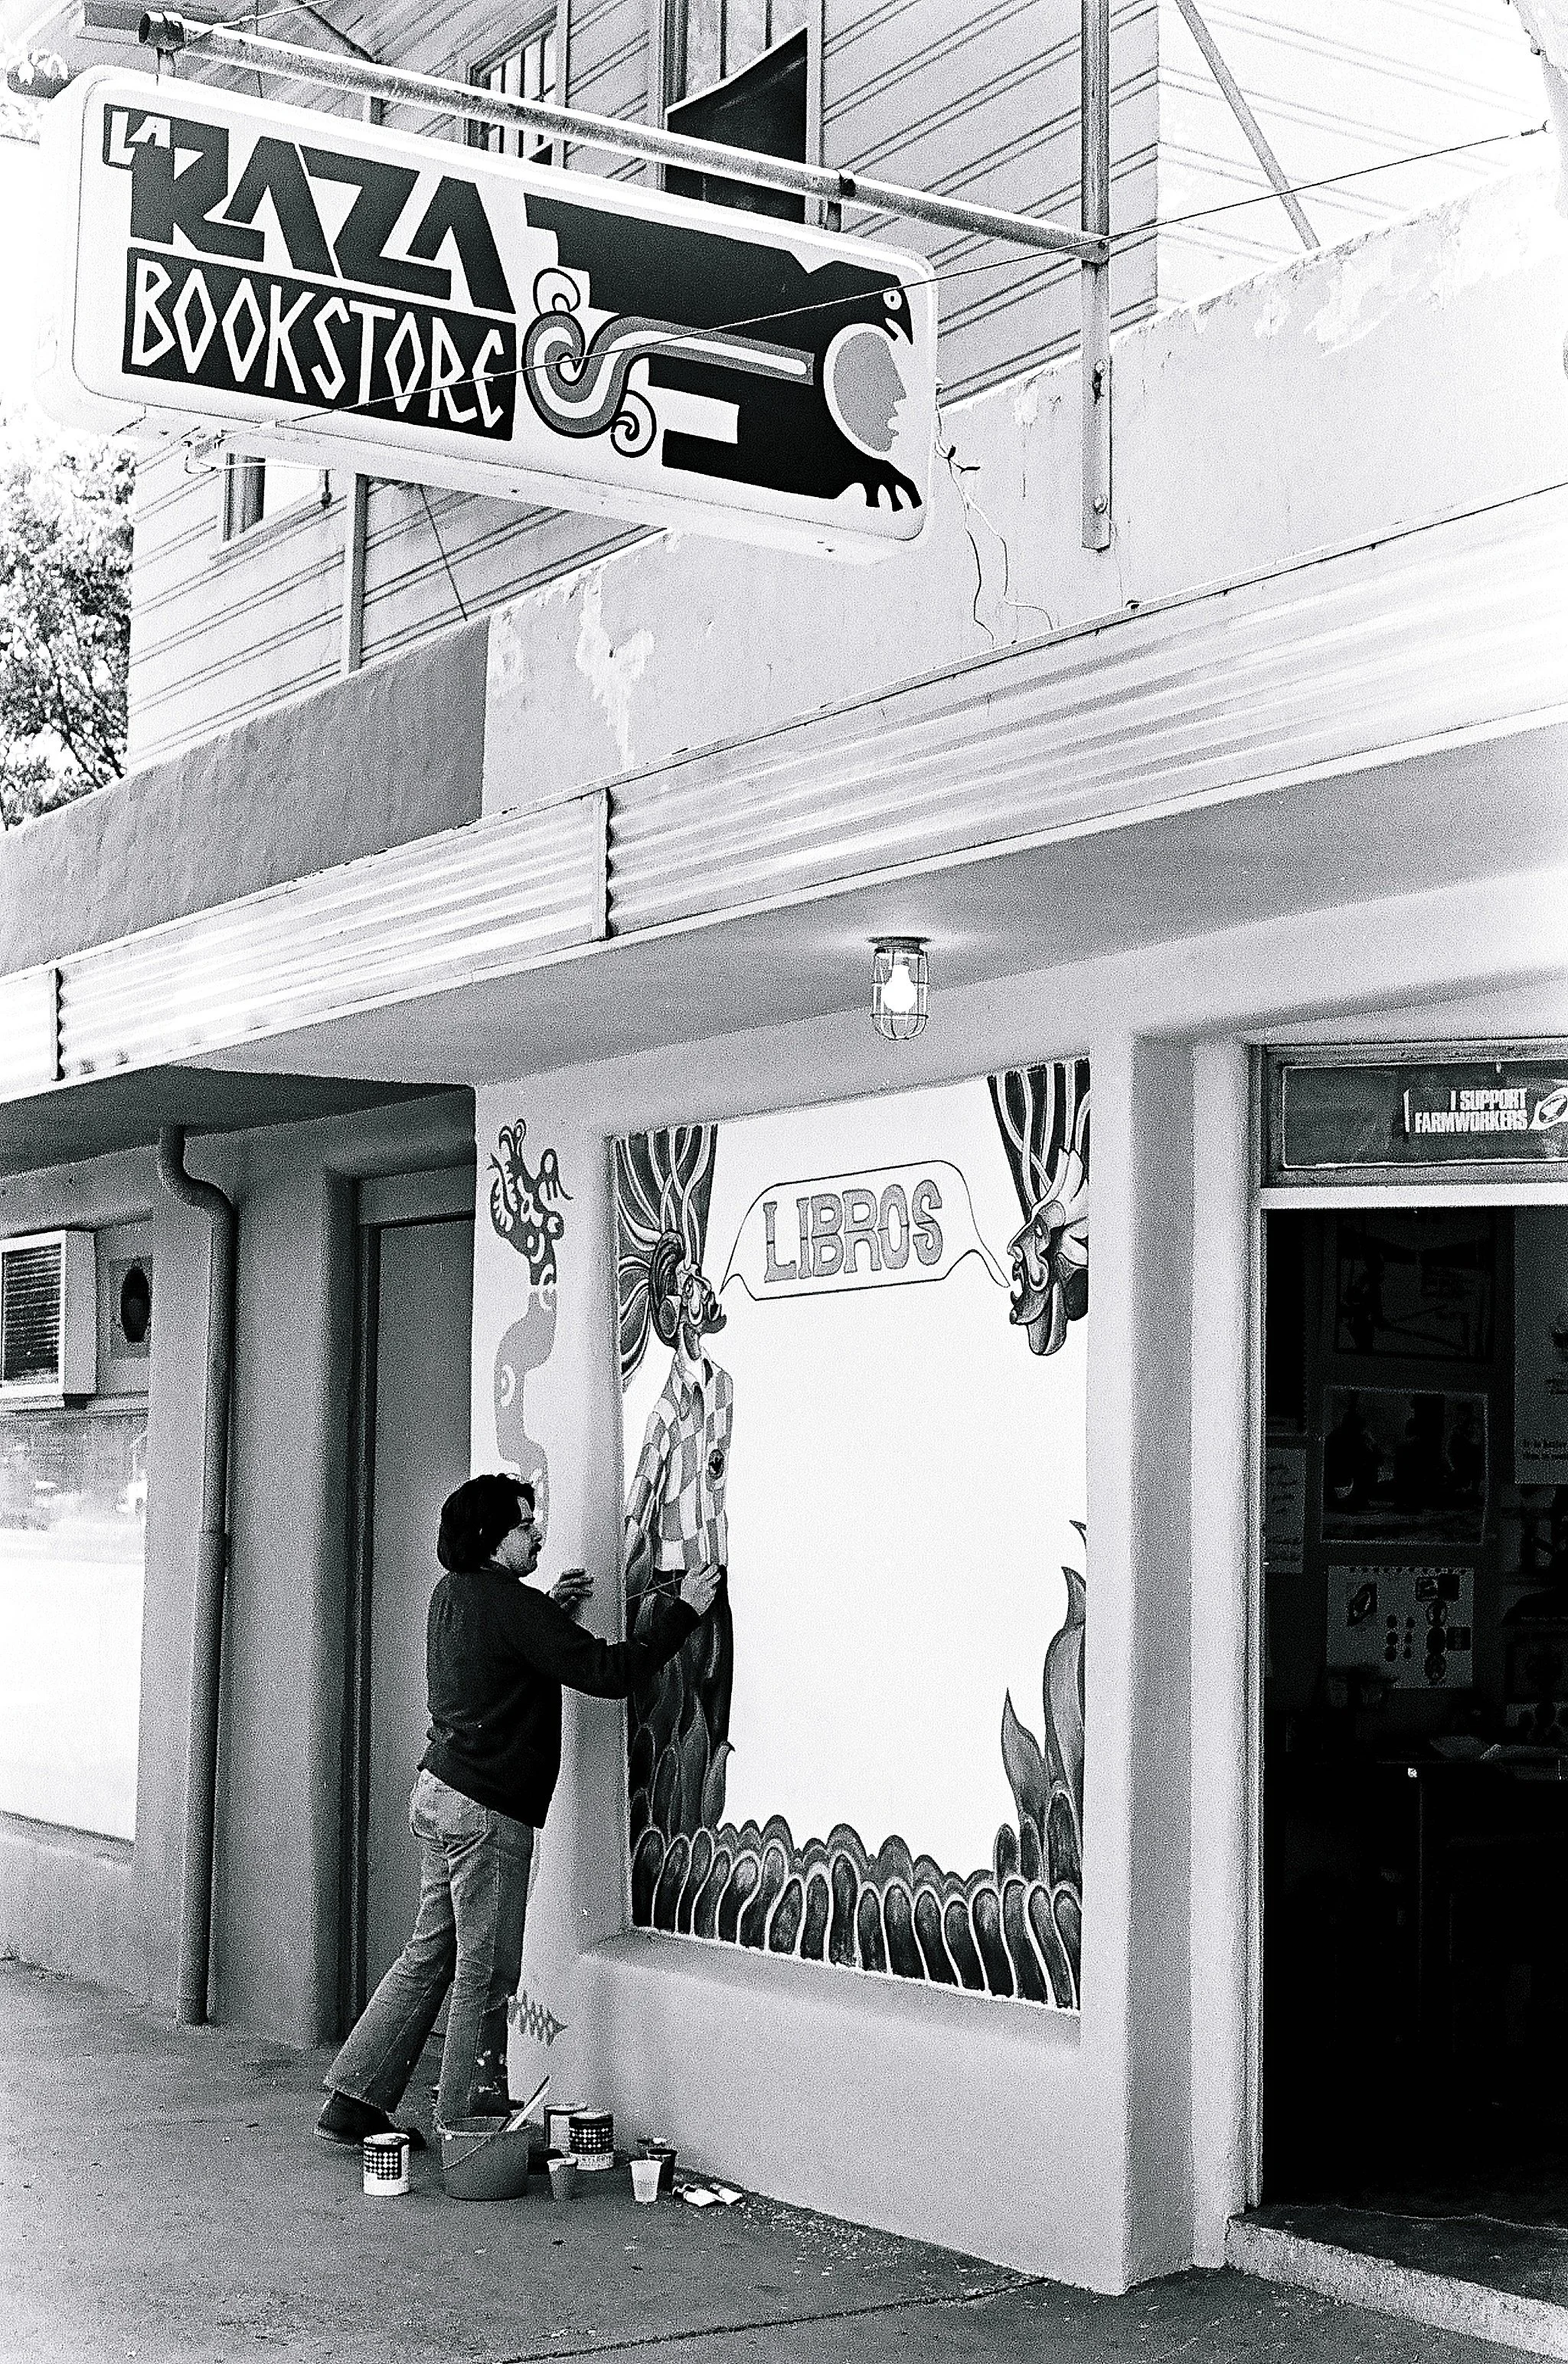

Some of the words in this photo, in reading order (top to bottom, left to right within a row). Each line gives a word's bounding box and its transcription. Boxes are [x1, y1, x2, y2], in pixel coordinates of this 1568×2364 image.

[107, 110, 172, 166] LA
[129, 116, 517, 315] RAZA
[130, 257, 505, 428] BOOKSTORE
[1415, 1110, 1528, 1133] FARMWORKERS
[1450, 1089, 1457, 1111] I
[1459, 1087, 1527, 1111] SUPPORT
[763, 1179, 943, 1283] LIBROS
